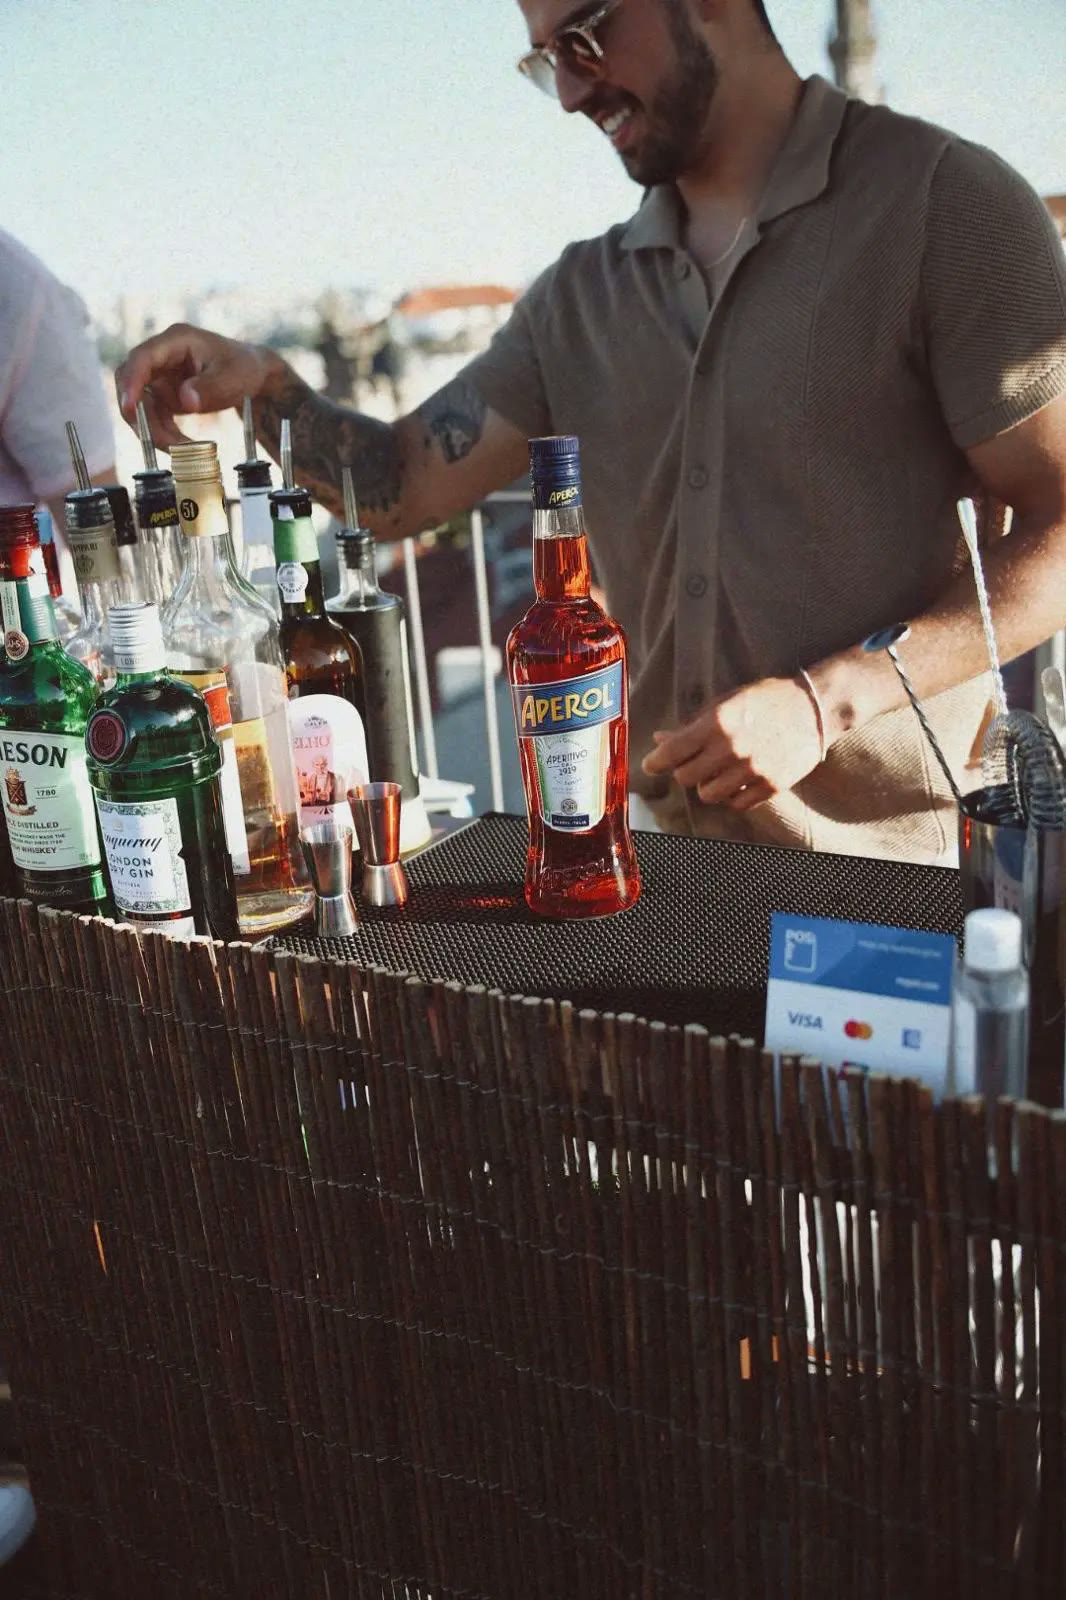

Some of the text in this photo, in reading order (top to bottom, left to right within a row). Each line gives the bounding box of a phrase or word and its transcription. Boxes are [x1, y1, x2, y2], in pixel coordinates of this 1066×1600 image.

[181, 501, 197, 518] 51
[521, 682, 615, 729] APEROL
[0, 741, 69, 769] ESON
[546, 749, 588, 765] APERITIVO
[559, 766, 577, 776] 1919
[36, 788, 57, 797] 1780
[17, 821, 60, 829] DISTILLED
[109, 853, 152, 867] ONDON
[129, 868, 154, 879] GIN
[787, 1011, 823, 1029] VISA
